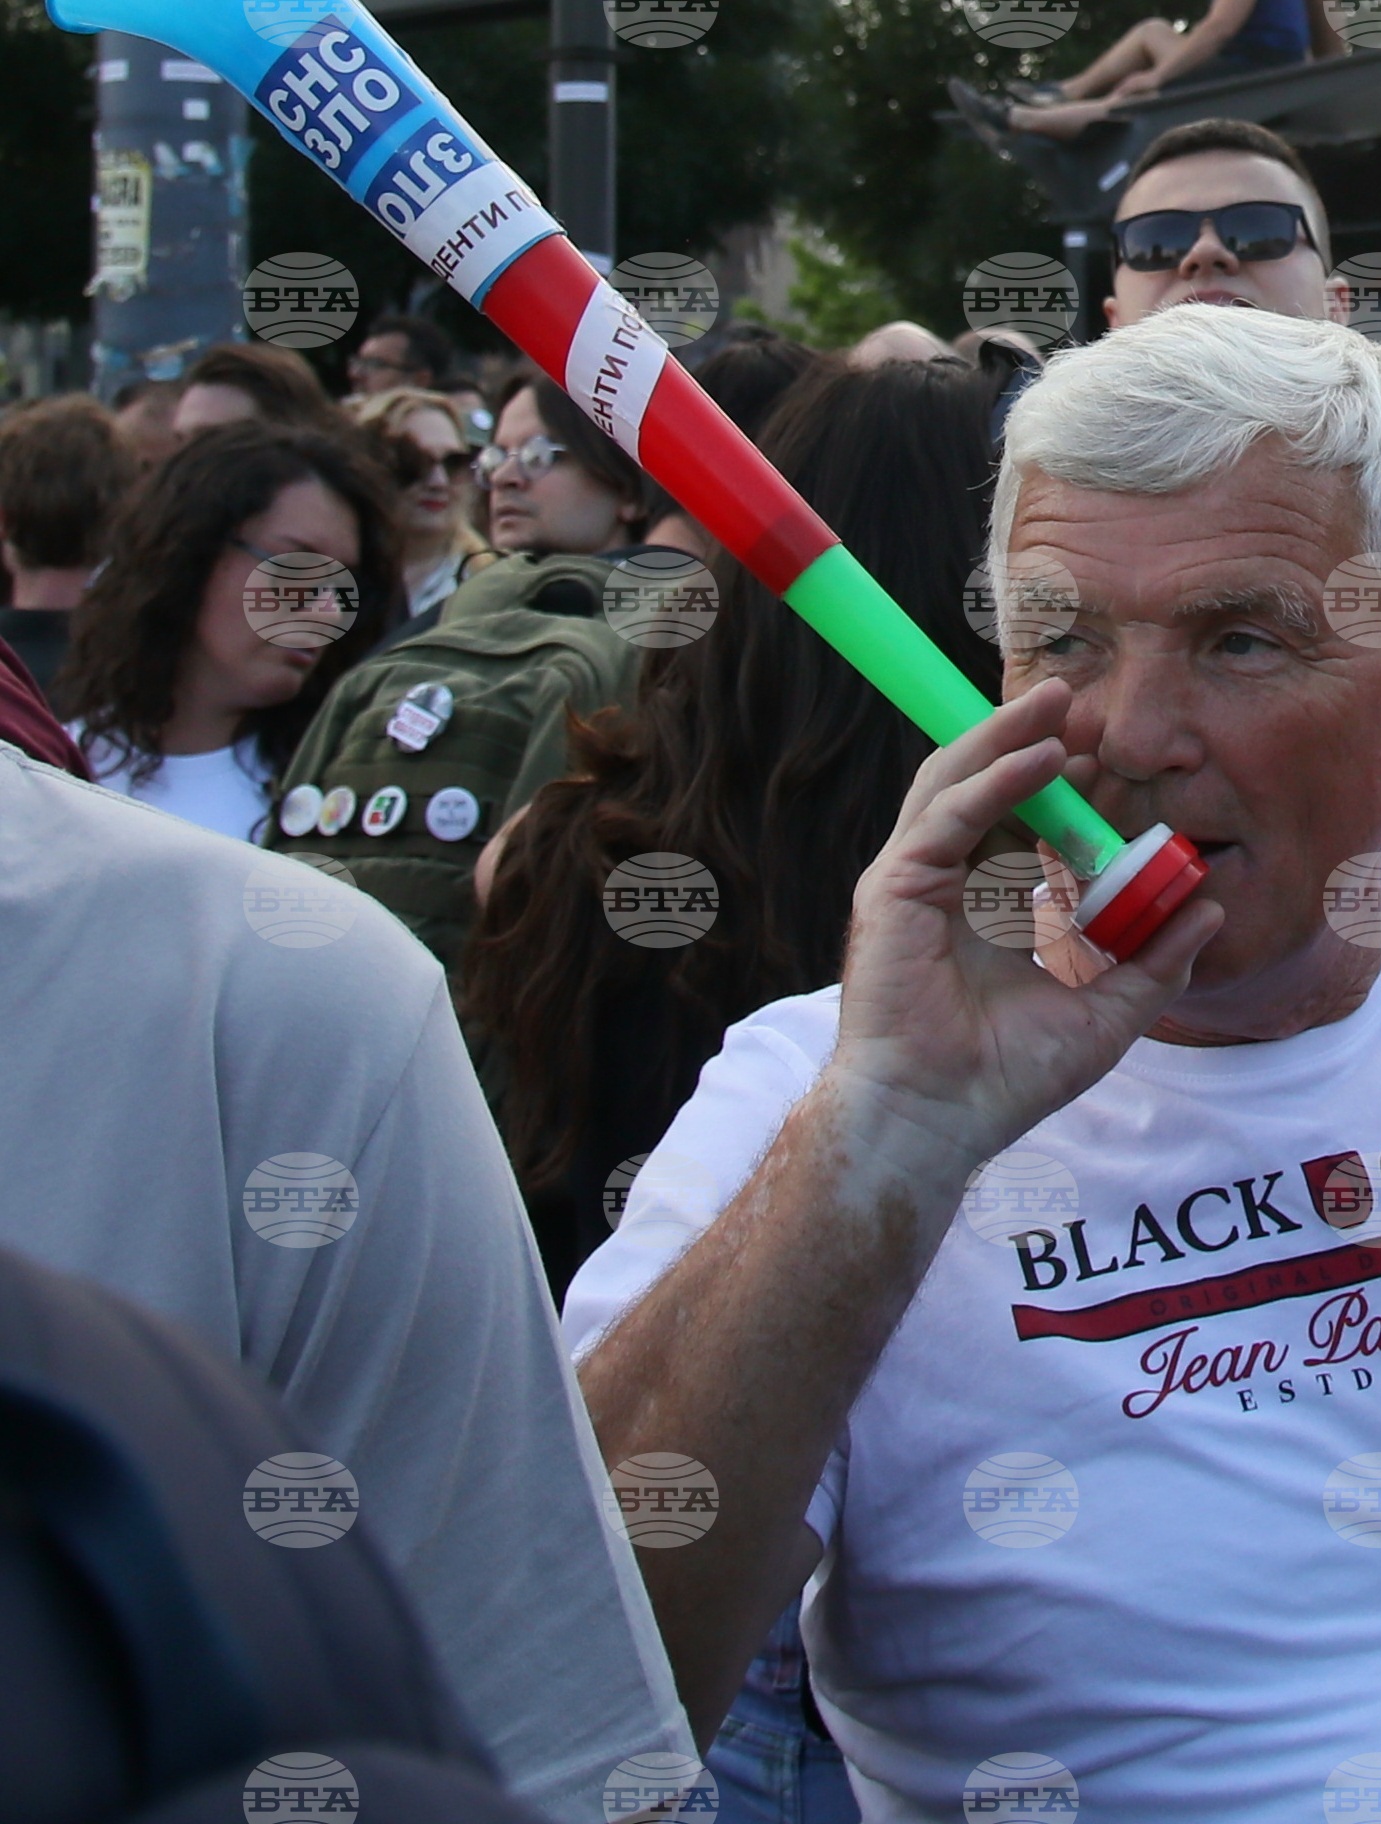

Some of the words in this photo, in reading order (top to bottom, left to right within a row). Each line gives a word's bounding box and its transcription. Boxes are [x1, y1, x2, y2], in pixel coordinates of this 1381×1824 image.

[268, 30, 367, 133] СНС
[304, 69, 400, 169] ЗЛО
[1007, 1171, 1300, 1292] BLACK
[1122, 1325, 1291, 1419] Jean
[1237, 1367, 1375, 1414] ESTD
